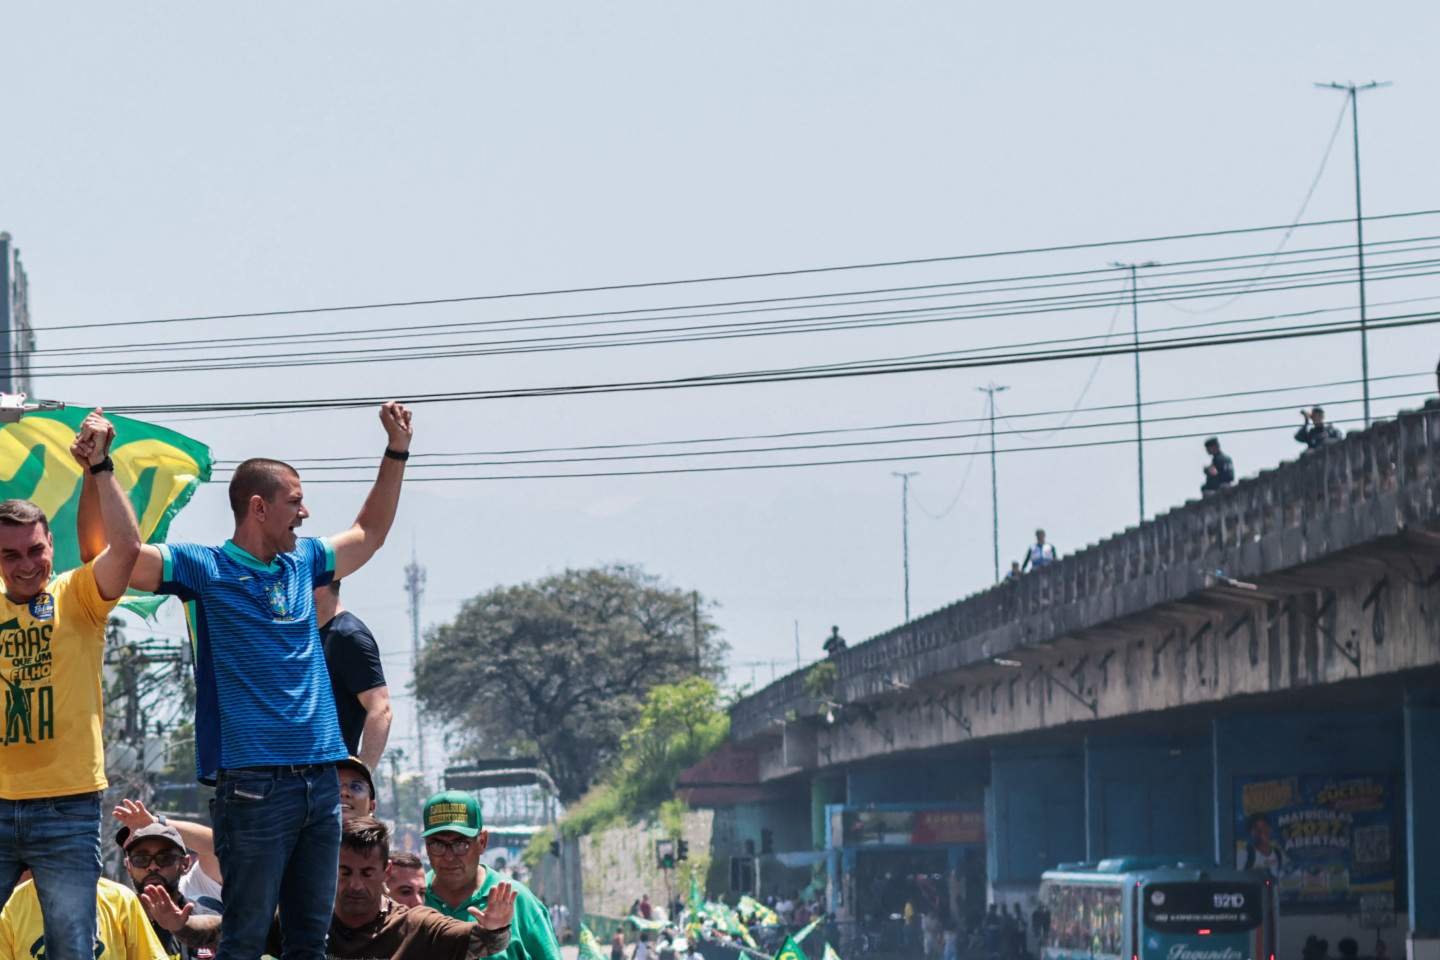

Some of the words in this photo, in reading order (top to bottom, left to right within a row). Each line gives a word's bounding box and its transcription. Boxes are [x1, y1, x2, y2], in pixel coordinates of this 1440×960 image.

[12, 655, 34, 668] QUE
[34, 652, 53, 664] UM
[10, 662, 52, 682] FILHO
